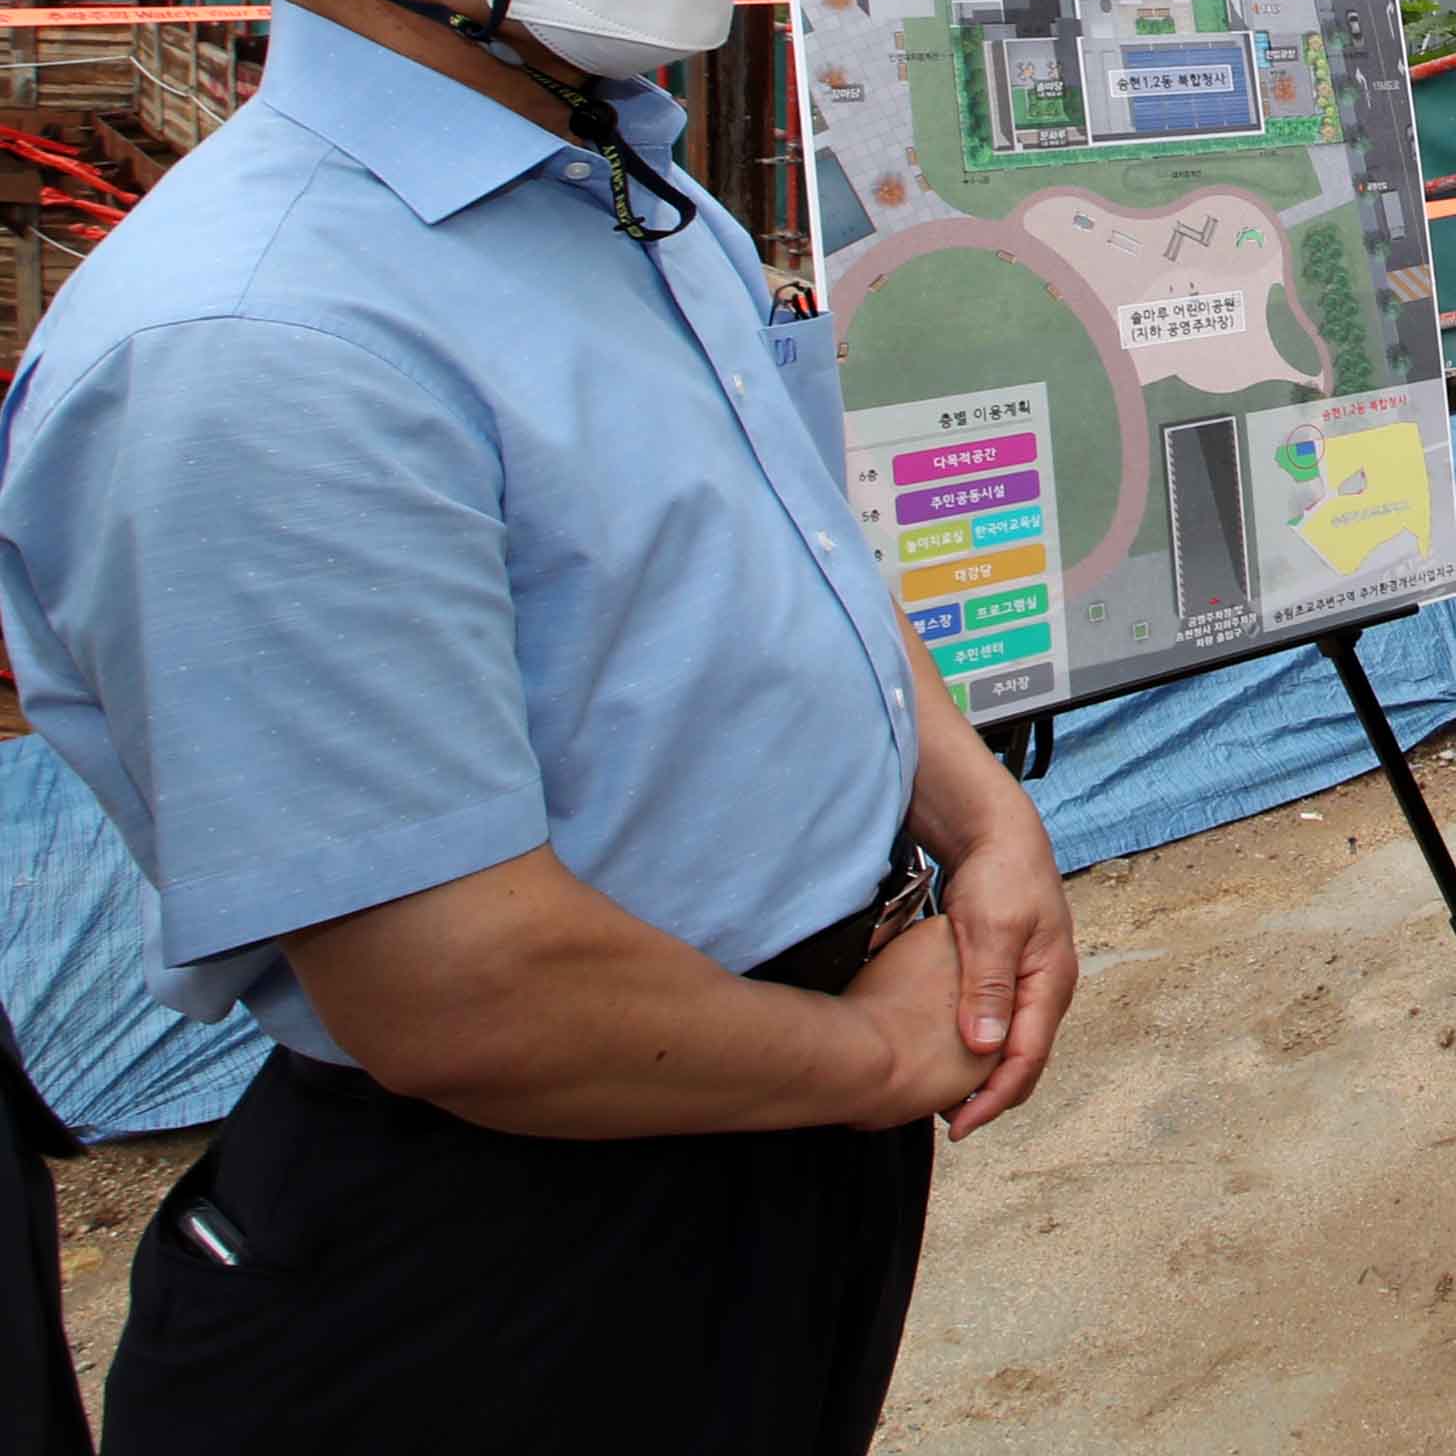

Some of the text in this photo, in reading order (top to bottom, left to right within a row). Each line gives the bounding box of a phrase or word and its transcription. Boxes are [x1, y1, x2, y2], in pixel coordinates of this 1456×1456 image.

[1178, 72, 1226, 87] 복합청사
[1131, 297, 1236, 326] 솔마루 어린이공원
[1131, 315, 1234, 342] (지하 공영주차장)
[938, 399, 1031, 429] 층별 이용계획
[932, 447, 997, 470] 다목적공간
[858, 468, 879, 482] 6층
[930, 483, 1006, 510] 주민공동시설
[861, 509, 881, 523] 5층
[954, 563, 993, 583] 대강당
[1272, 564, 1456, 624] 송림초교주변구역 주거환경개선사업지구
[975, 595, 1038, 621] 프로그램실
[954, 640, 1005, 665] 주민센터
[992, 675, 1031, 697] 주차장
